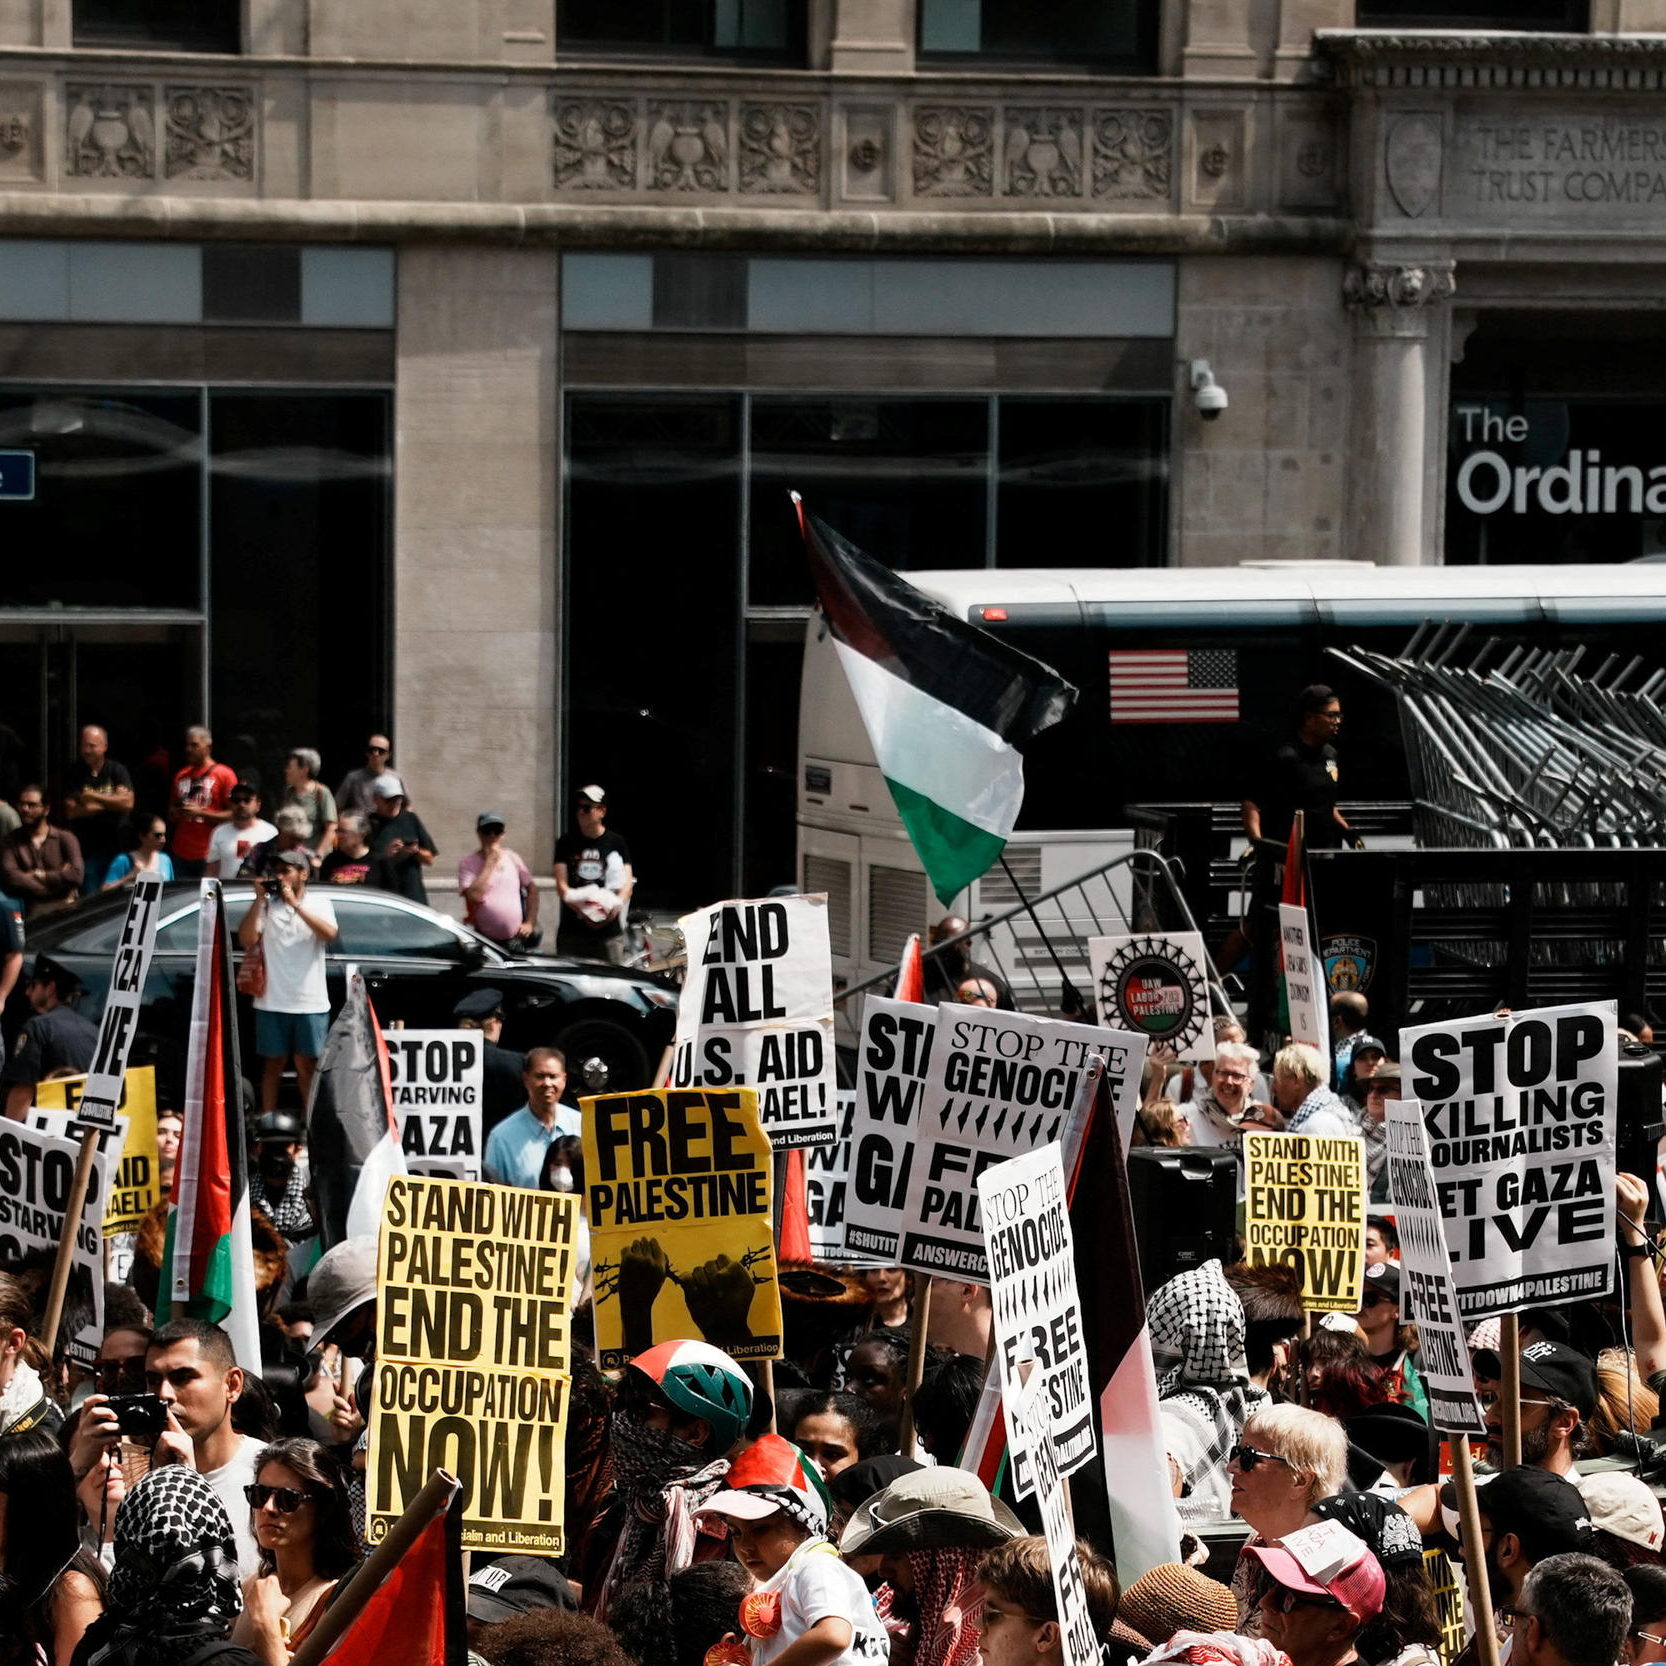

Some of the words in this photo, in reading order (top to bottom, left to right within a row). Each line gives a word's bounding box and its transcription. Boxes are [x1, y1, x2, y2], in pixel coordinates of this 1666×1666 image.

[1476, 127, 1533, 161] THE
[1472, 170, 1554, 201] TRUST
[1456, 407, 1530, 443] The
[705, 902, 789, 964] END
[701, 963, 788, 1024] ALL
[1129, 991, 1160, 1004] LABOR
[676, 1036, 746, 1089] U.S.
[764, 1029, 823, 1082] AID
[951, 1021, 1043, 1062] STOP
[1412, 1015, 1606, 1101] STOP
[597, 1090, 755, 1181] FREE
[1249, 1136, 1308, 1160] STAND
[1313, 1140, 1359, 1163] WITH
[590, 1171, 768, 1227] PALESTINE
[986, 1179, 1030, 1232] STOP
[1034, 1163, 1062, 1212] THE
[1250, 1162, 1361, 1189] PALESTINE!
[1496, 1159, 1604, 1212] GAZA
[388, 1179, 496, 1235] STAND
[502, 1191, 573, 1245] WITH
[1250, 1188, 1308, 1222] END
[1314, 1191, 1361, 1224] THE
[386, 1232, 569, 1296] PALESTINE!
[990, 1202, 1069, 1277] GENOCIDE
[1250, 1224, 1360, 1250] OCCUPATION
[1409, 1272, 1453, 1324] FREE
[384, 1286, 484, 1361] END
[492, 1296, 566, 1369] THE
[380, 1365, 562, 1423] OCCUPATION
[374, 1413, 554, 1523] NOW!
